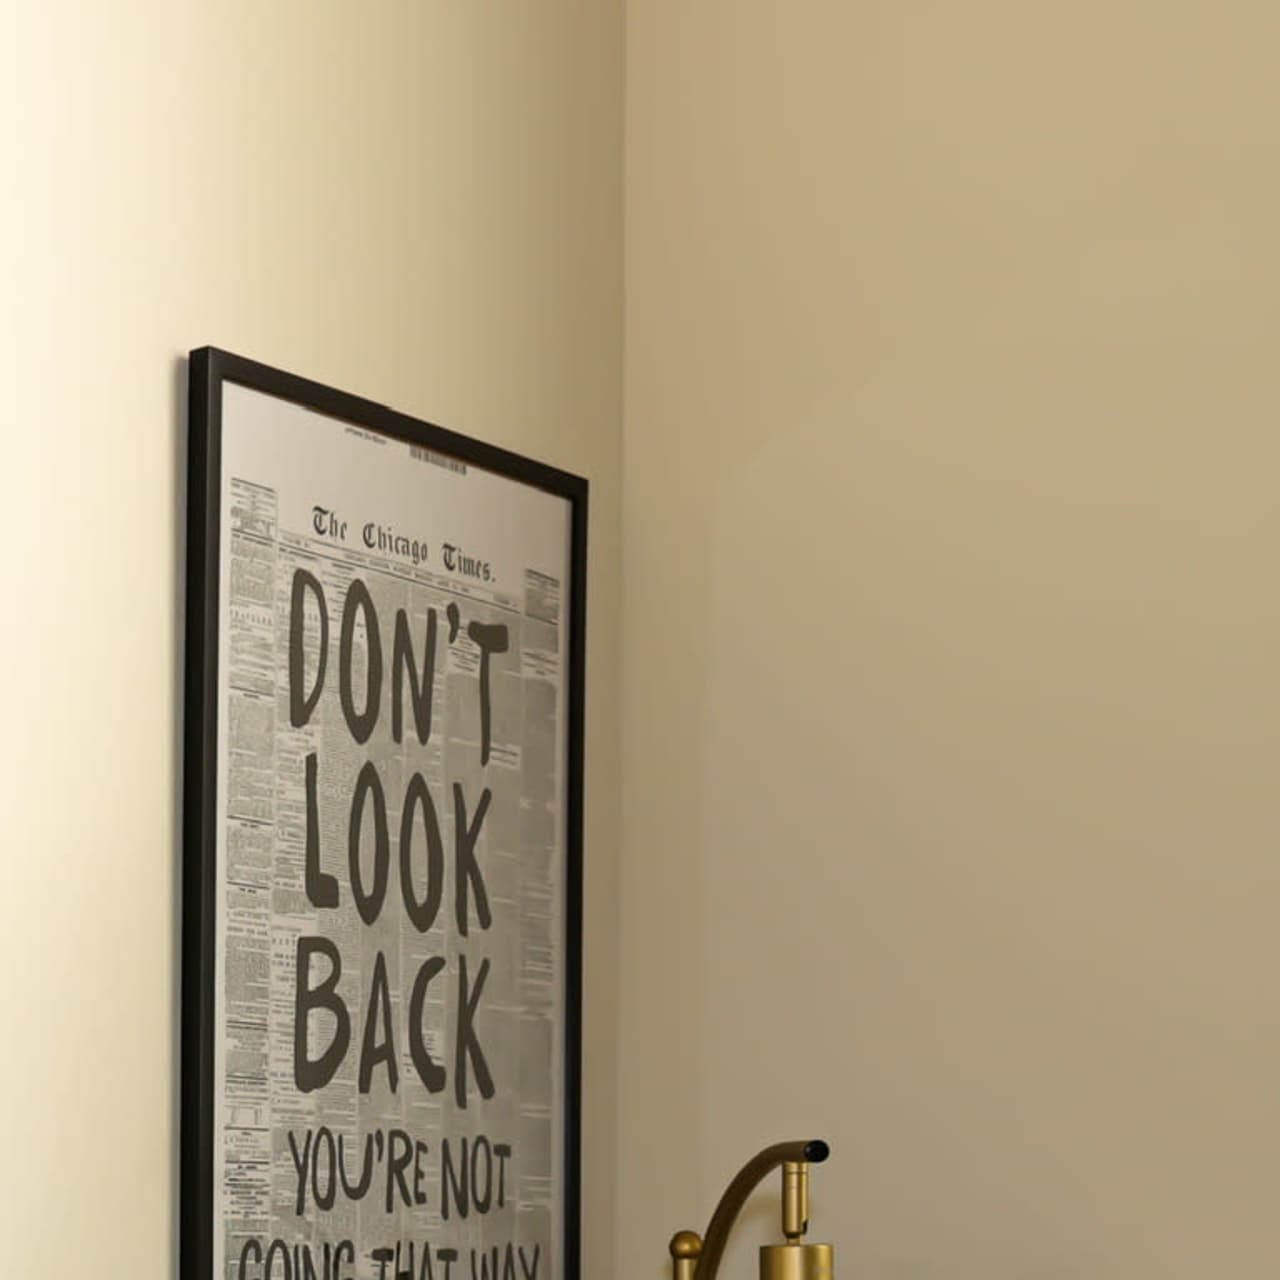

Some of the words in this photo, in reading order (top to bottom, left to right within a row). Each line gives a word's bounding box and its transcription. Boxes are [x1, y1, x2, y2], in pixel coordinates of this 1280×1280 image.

[312, 505, 348, 541] The
[362, 521, 429, 565] Chicago
[442, 542, 497, 584] Times.
[289, 568, 509, 766] DON'T
[304, 752, 492, 938] LOOK
[293, 936, 496, 1110] BACK
[288, 1126, 429, 1216] YOU'RE
[441, 1135, 512, 1220] NOT
